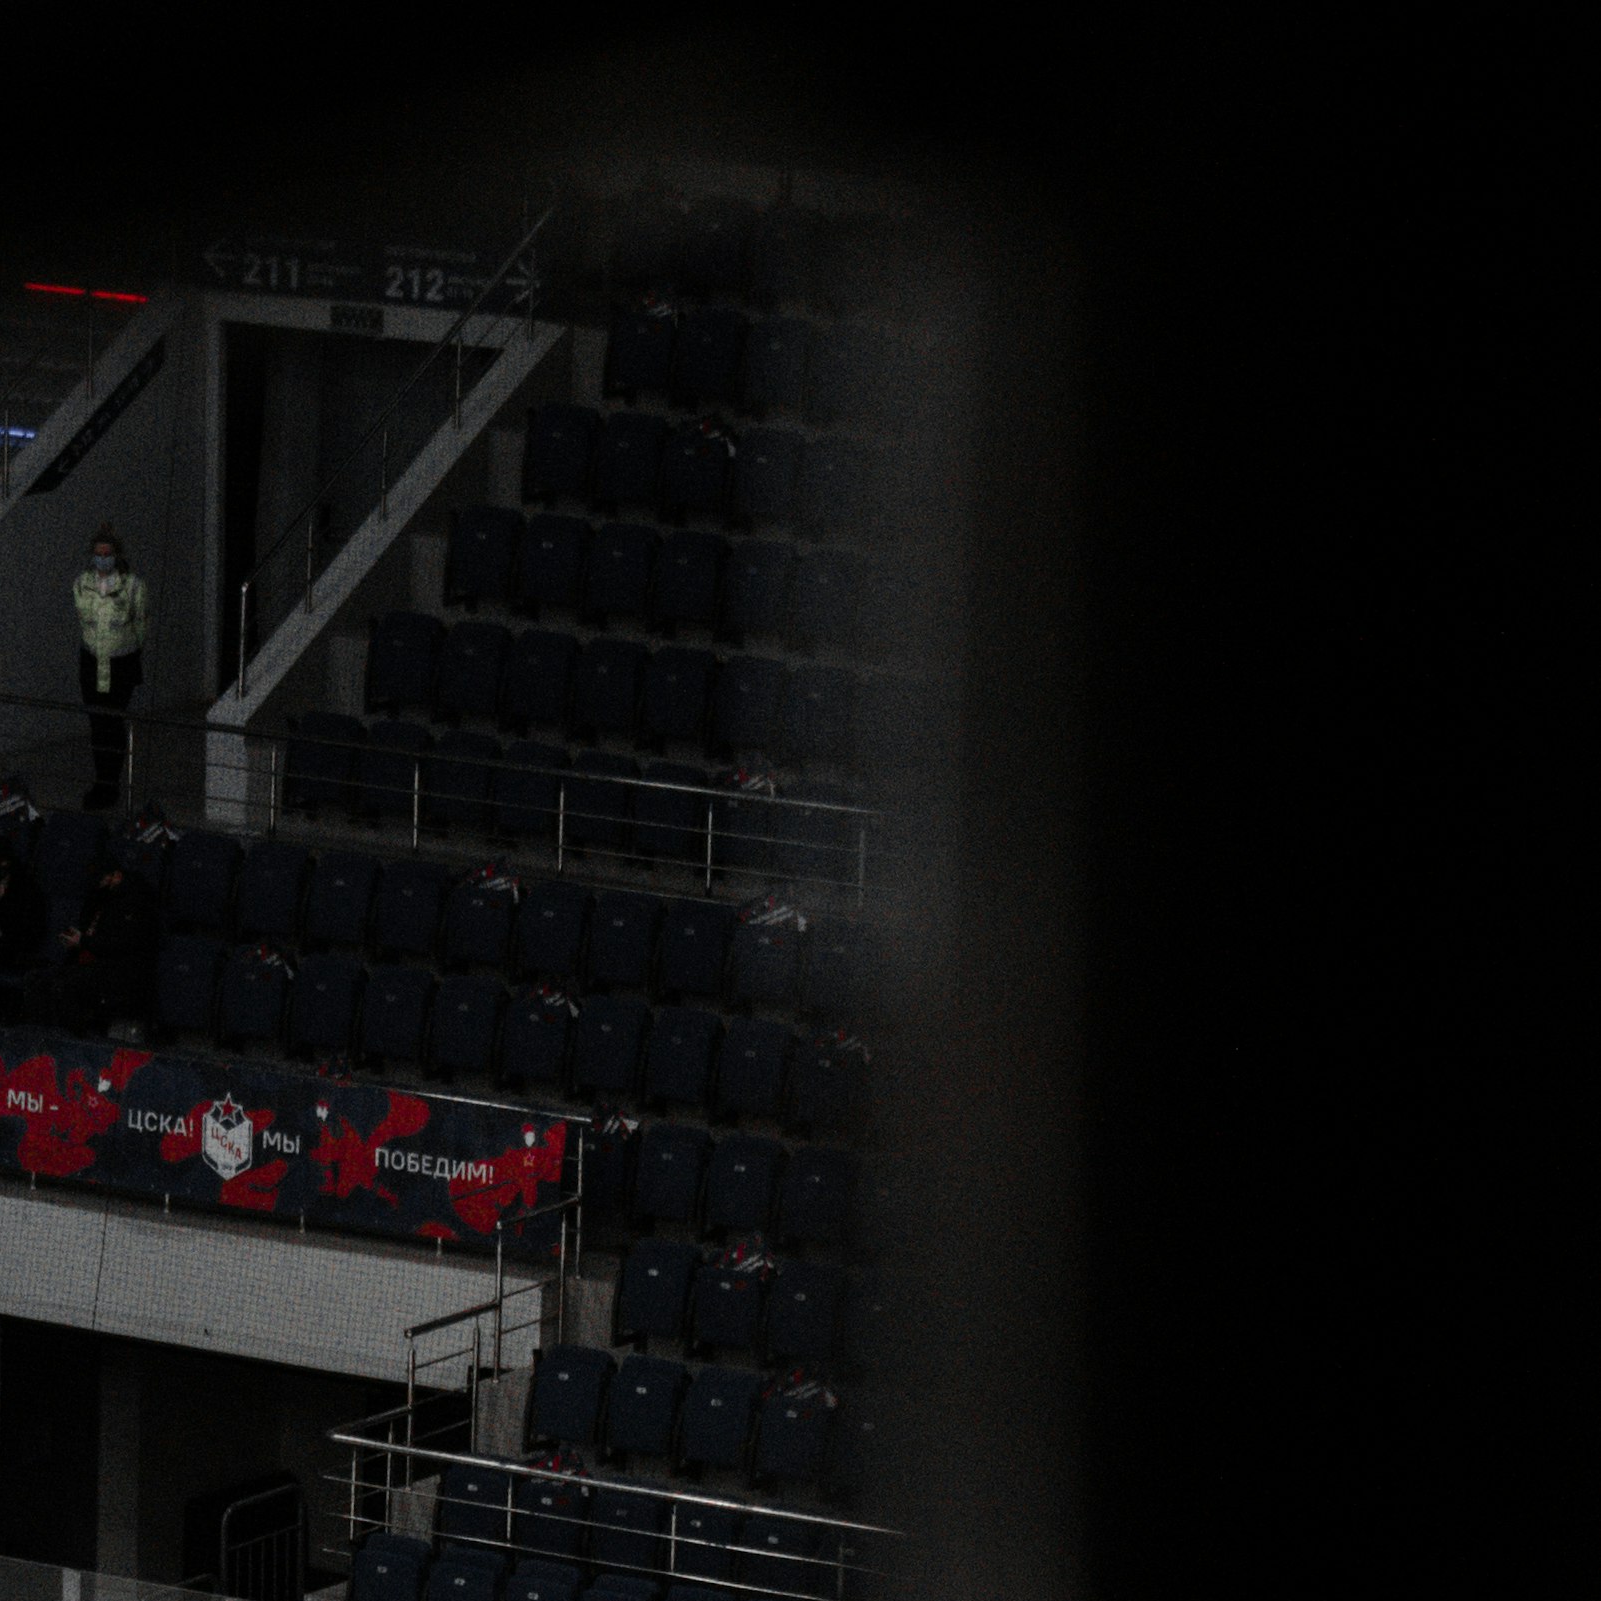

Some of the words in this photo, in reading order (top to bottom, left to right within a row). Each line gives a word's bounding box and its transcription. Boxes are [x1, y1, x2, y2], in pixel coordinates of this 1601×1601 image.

[242, 252, 300, 289] 211
[384, 263, 444, 301] 212
[6, 1088, 44, 1114] МЫ
[127, 1108, 195, 1138] ЦСКА!
[262, 1130, 301, 1155] МЫ
[374, 1147, 495, 1184] ПОБЕДИМ!
